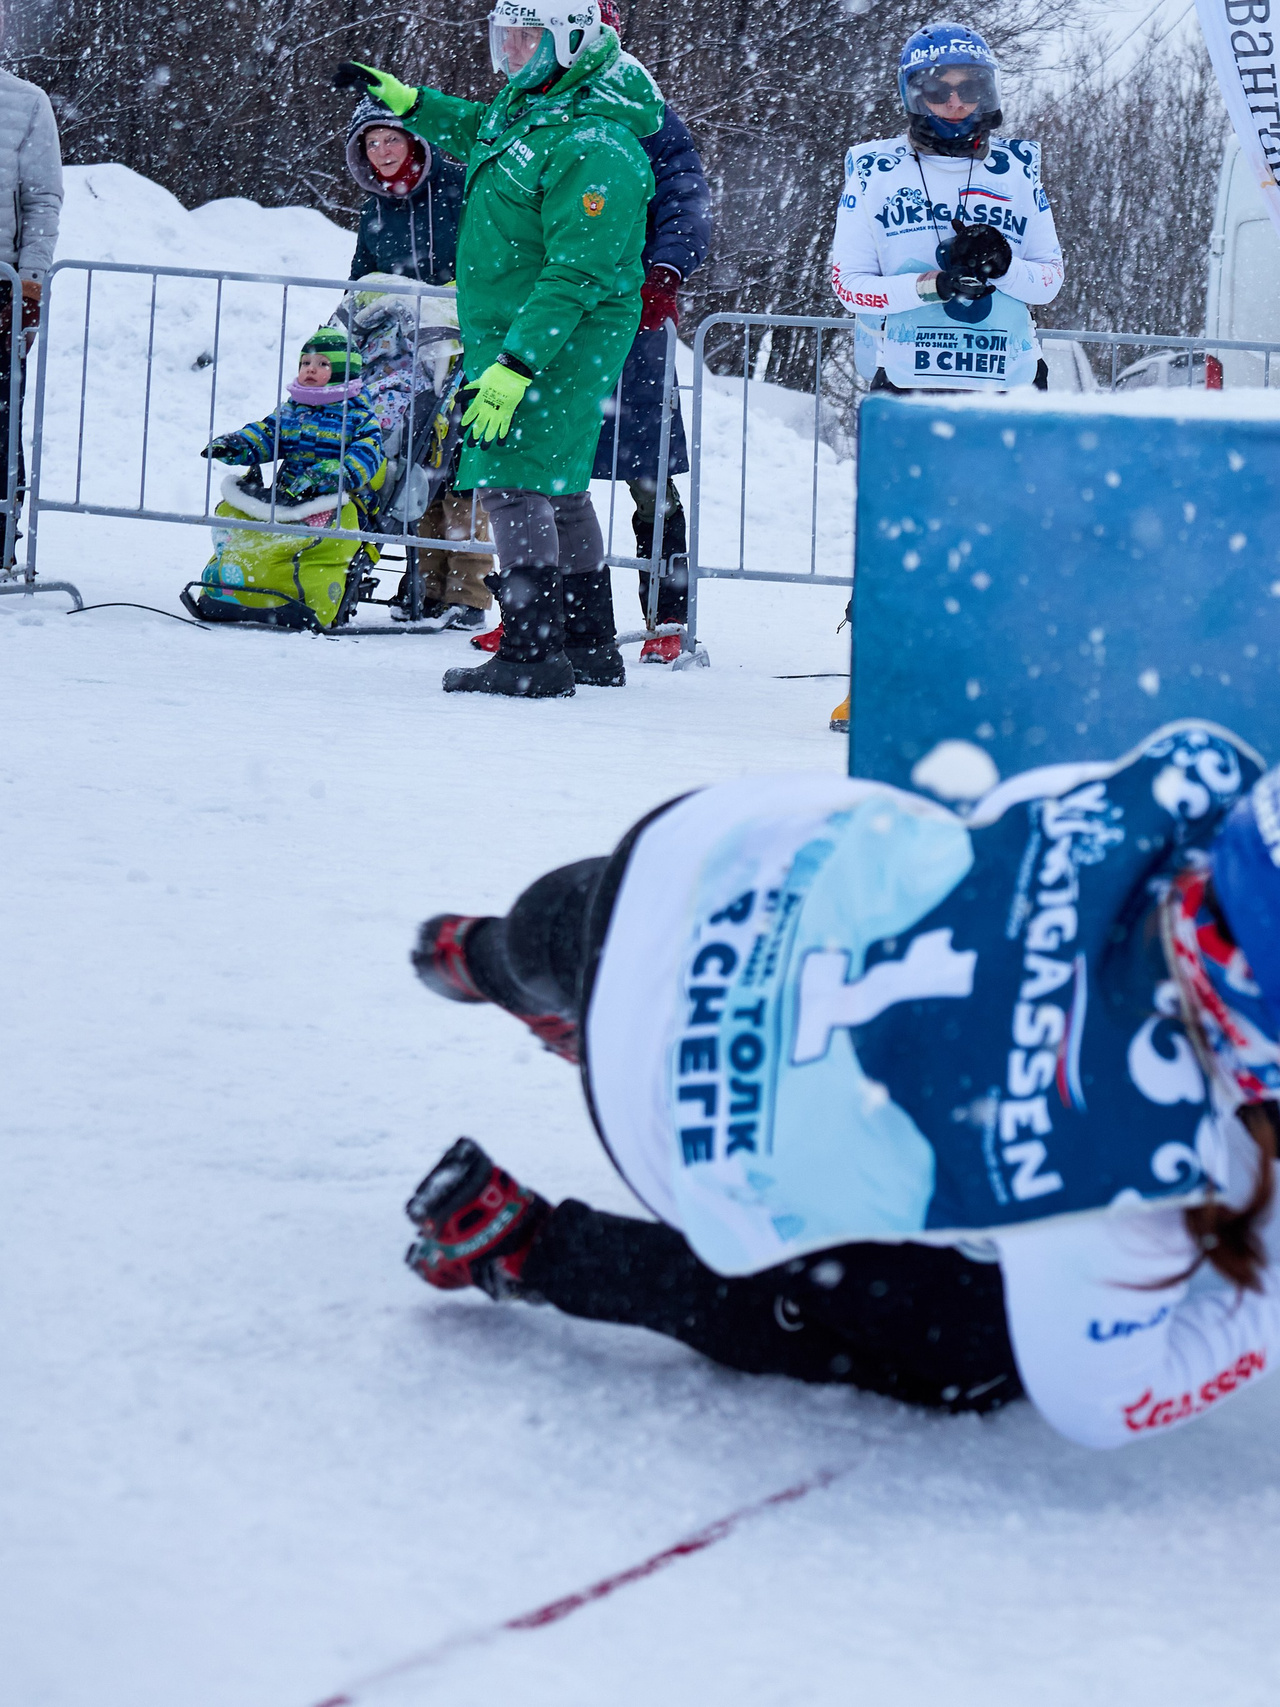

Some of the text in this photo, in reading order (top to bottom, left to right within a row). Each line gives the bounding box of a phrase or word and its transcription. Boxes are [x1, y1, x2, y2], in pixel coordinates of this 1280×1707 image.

[914, 350, 1006, 374] В СНЕГЕ
[915, 332, 958, 341] ДЛЯ ТЕХ,
[963, 333, 1007, 351] ТОЛК
[791, 928, 977, 1065] 1
[678, 942, 739, 1168] СНЕГЕ
[726, 997, 765, 1158] ТОЛК
